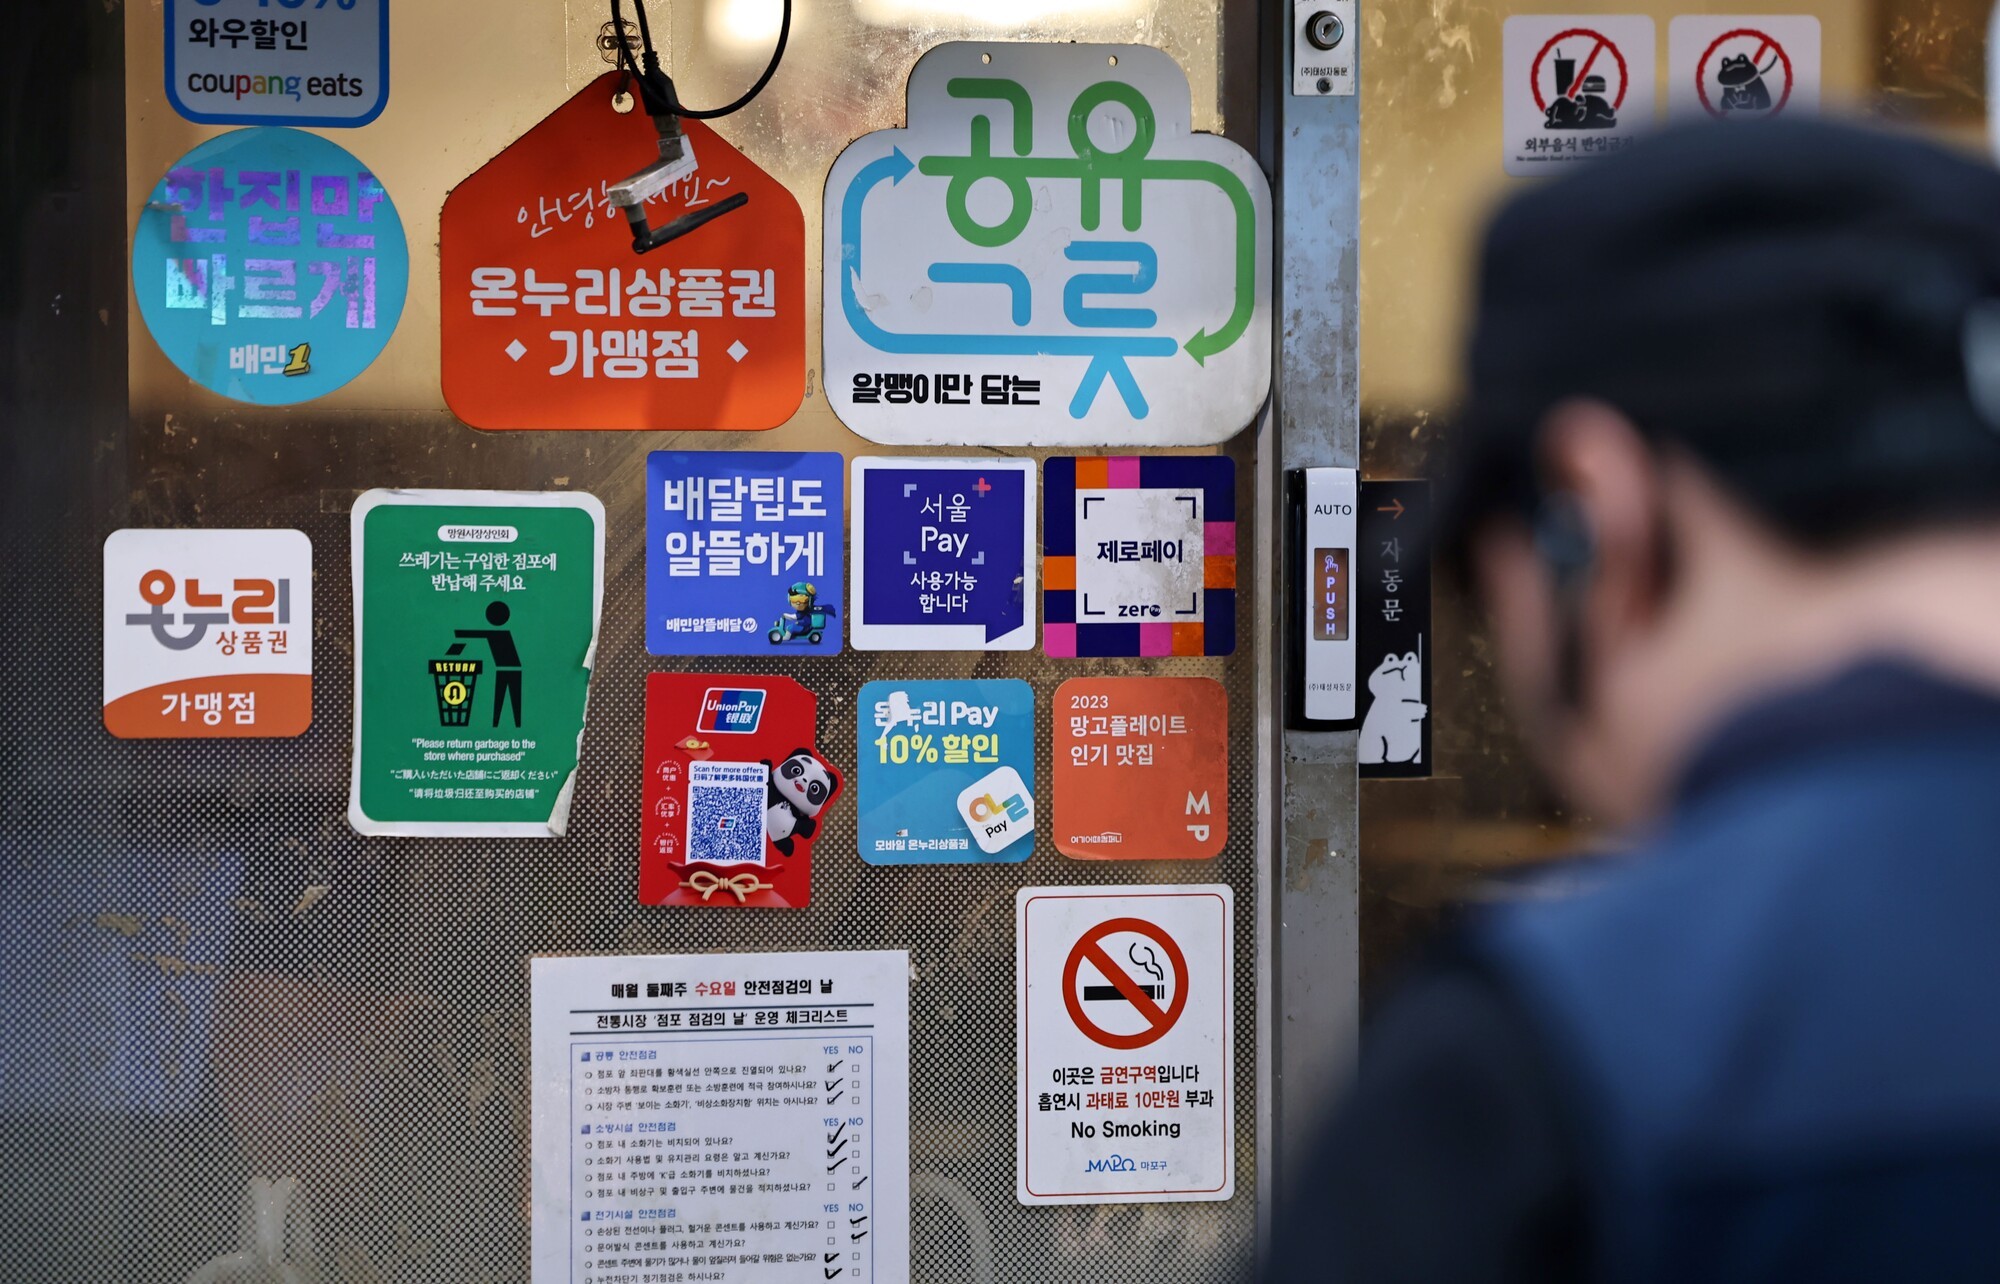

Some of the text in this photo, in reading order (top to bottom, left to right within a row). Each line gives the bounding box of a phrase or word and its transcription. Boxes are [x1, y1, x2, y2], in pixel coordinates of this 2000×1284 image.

[188, 18, 308, 50] 와우할인
[188, 72, 362, 101] coupang eats
[1525, 136, 1577, 152] 외부음식
[165, 167, 384, 249] 한집만
[166, 254, 376, 328] 바르게
[470, 267, 776, 318] 온누리상품권
[230, 342, 312, 376] 배민1
[550, 329, 699, 378] 가맹점
[852, 373, 1040, 405] 알맹이만 담는
[664, 476, 826, 522] 배달팁도
[920, 494, 971, 522] 서울
[1314, 504, 1352, 516] AUTO
[447, 528, 510, 540] 망원시장상인회
[921, 526, 969, 558] Pay
[666, 530, 824, 576] 알뜰하게
[1097, 540, 1183, 563] 제로페이
[399, 552, 557, 572] 쓰레기는 구입한 점포에
[432, 574, 526, 592] 반납해 주세요
[910, 571, 978, 591] 사용가능
[1381, 538, 1403, 622] 자동문
[126, 569, 290, 650] 온누리
[919, 593, 968, 613] 합니다
[1325, 576, 1336, 636] PUSH
[666, 617, 741, 632] 배민알뜰배달
[216, 630, 288, 656] 상품권
[436, 662, 476, 673] RETURN
[161, 692, 256, 726] 가맹점
[707, 700, 758, 718] UnionPay
[1071, 695, 1108, 709] 2023
[951, 701, 998, 728] Pay
[1070, 714, 1187, 737] 망고플레이트
[412, 738, 536, 750] "Please return garbage to the
[874, 734, 998, 764] 10% 할인
[424, 751, 526, 763] store where purchased"
[1071, 744, 1153, 766] 인기 맛집
[985, 820, 1008, 838] Pay
[875, 838, 968, 851] 모바일 온누리상품권
[612, 979, 833, 998] 매월 둘째주 수요일 안전점검의 날
[596, 1014, 647, 1028] 전통시장
[689, 1012, 725, 1026] 점검의
[754, 1011, 778, 1024] 운영
[786, 1010, 848, 1024] 체크리스트
[618, 1049, 656, 1060] 안전점검
[824, 1046, 863, 1054] YES NO
[1052, 1065, 1200, 1085] 이곳은 금연구역입니다
[1038, 1090, 1214, 1111] 흡연시 과태료 10만원 부과
[595, 1121, 676, 1134] 소방시설 안전점검
[824, 1118, 863, 1126] YES NO
[1072, 1120, 1180, 1138] No Smoking
[1140, 1160, 1168, 1171] 마포구
[595, 1208, 676, 1220] 전기시설 안전점검
[824, 1204, 864, 1212] YES NO
